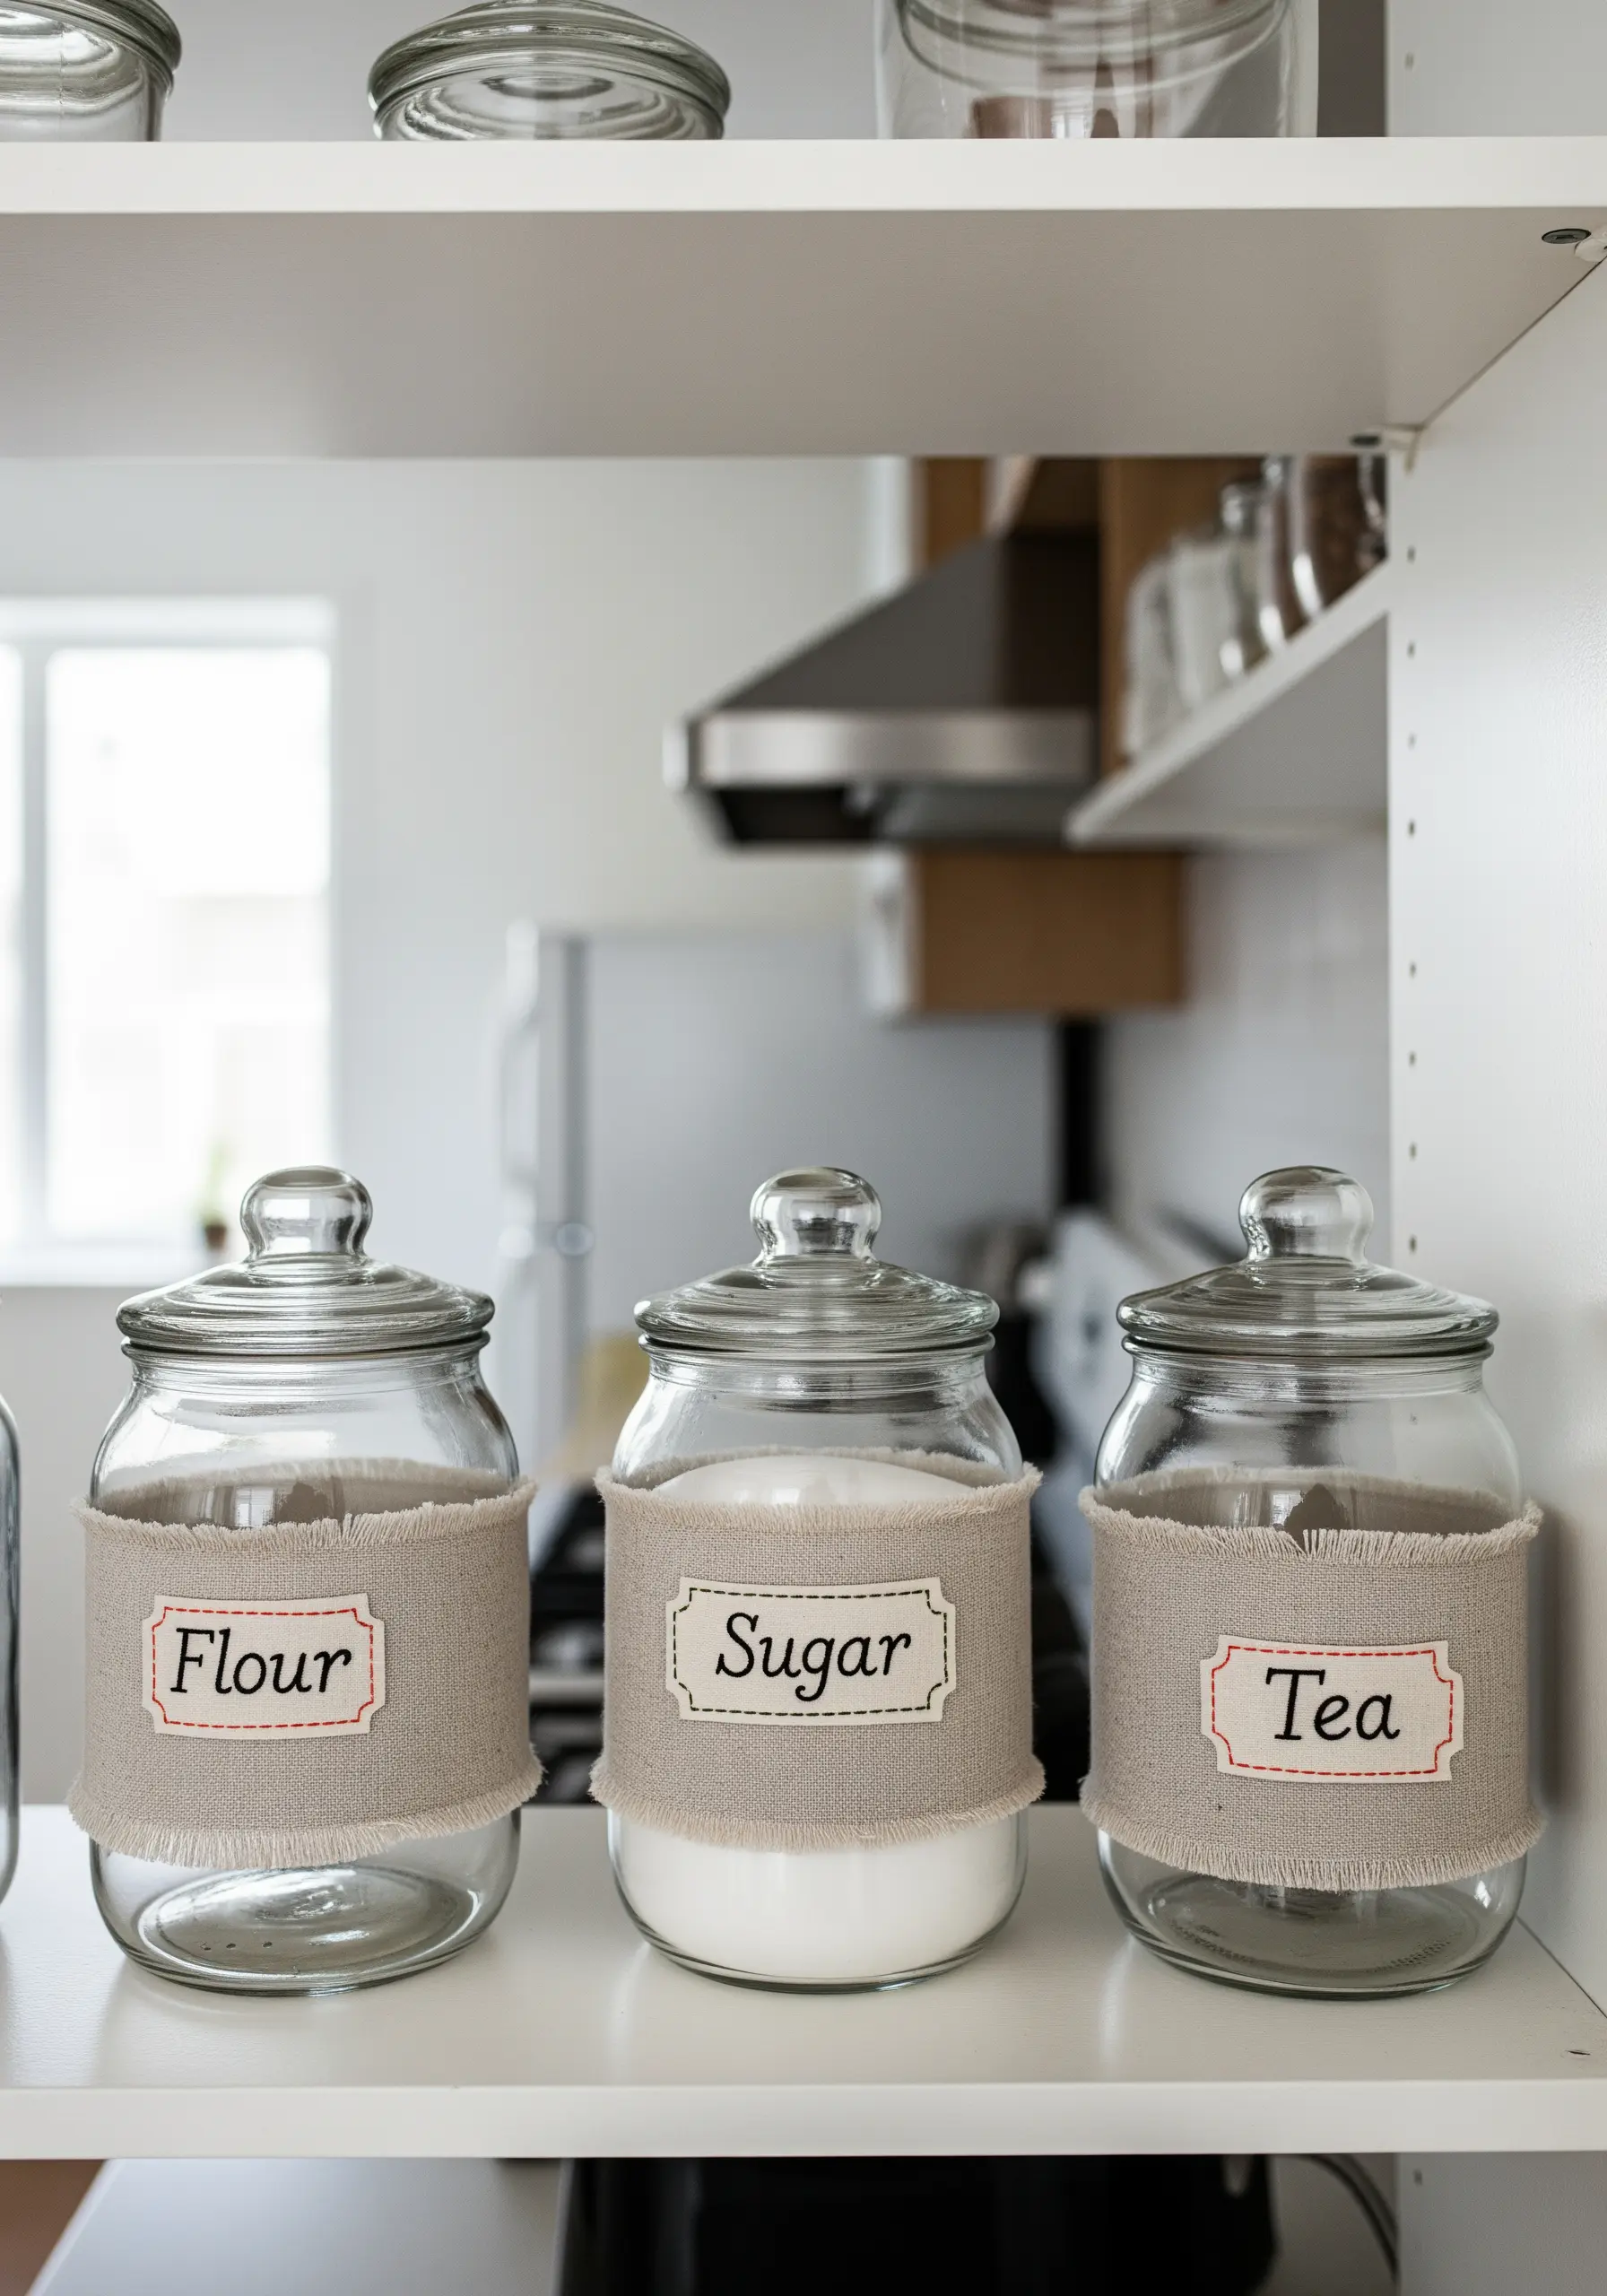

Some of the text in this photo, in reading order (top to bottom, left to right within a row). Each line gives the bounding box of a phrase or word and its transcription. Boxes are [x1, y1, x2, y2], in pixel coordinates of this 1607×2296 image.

[169, 1627, 352, 1695] Flour
[715, 1612, 912, 1702] Sugar
[1265, 1666, 1401, 1742] Tea
